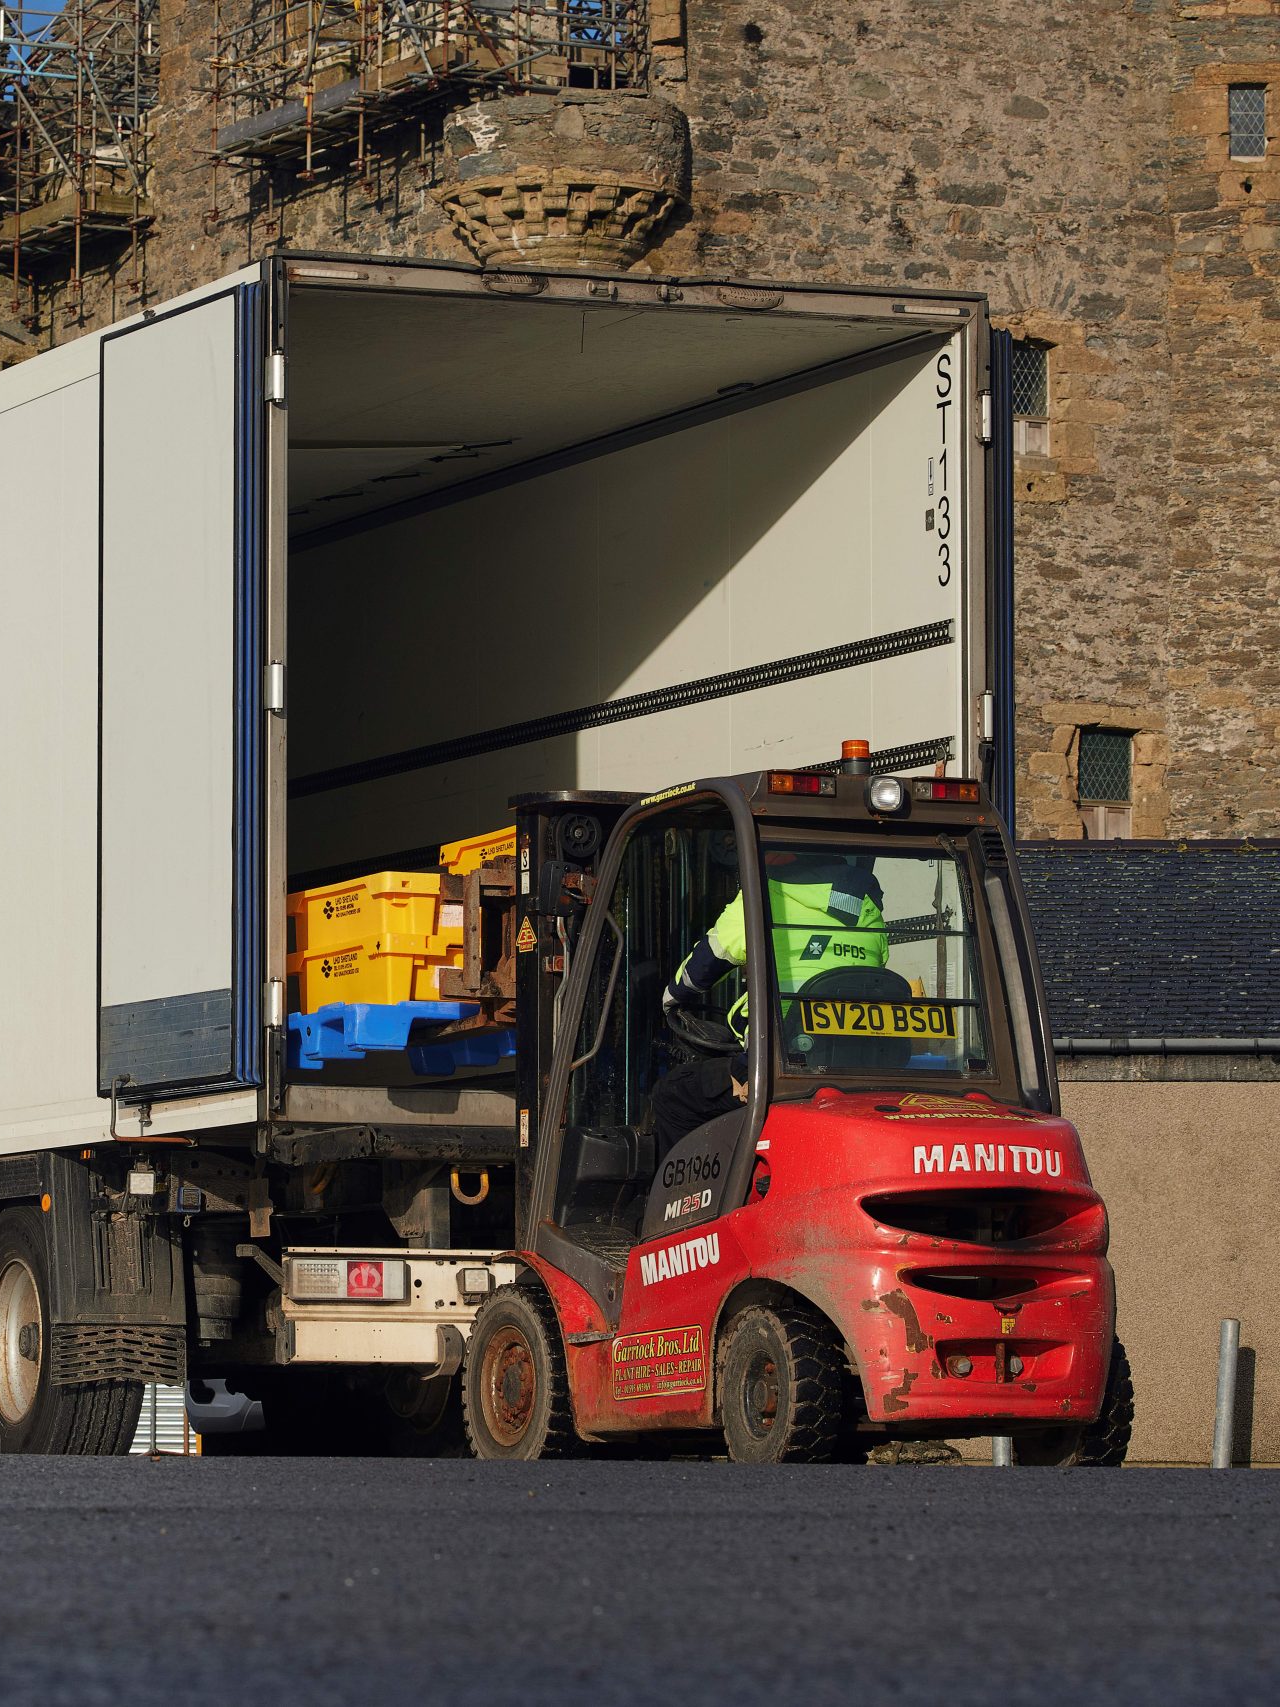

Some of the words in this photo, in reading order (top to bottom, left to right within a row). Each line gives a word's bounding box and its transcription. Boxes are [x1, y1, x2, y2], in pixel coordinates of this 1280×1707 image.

[936, 354, 952, 587] ST133
[495, 841, 515, 854] SHETLAND
[342, 894, 359, 904] SHETLAND
[340, 952, 358, 963] SHETLAND
[833, 943, 866, 960] DFDS
[813, 1002, 884, 1031] SV20
[891, 1005, 945, 1033] BSO
[662, 1152, 720, 1188] GB1966
[913, 1143, 1062, 1177] MANITOU
[640, 1232, 720, 1286] MANITOU
[614, 1338, 655, 1363] Garriock
[657, 1335, 681, 1357] Bros.
[682, 1331, 699, 1353] Ltd
[615, 1366, 634, 1381] PLANT
